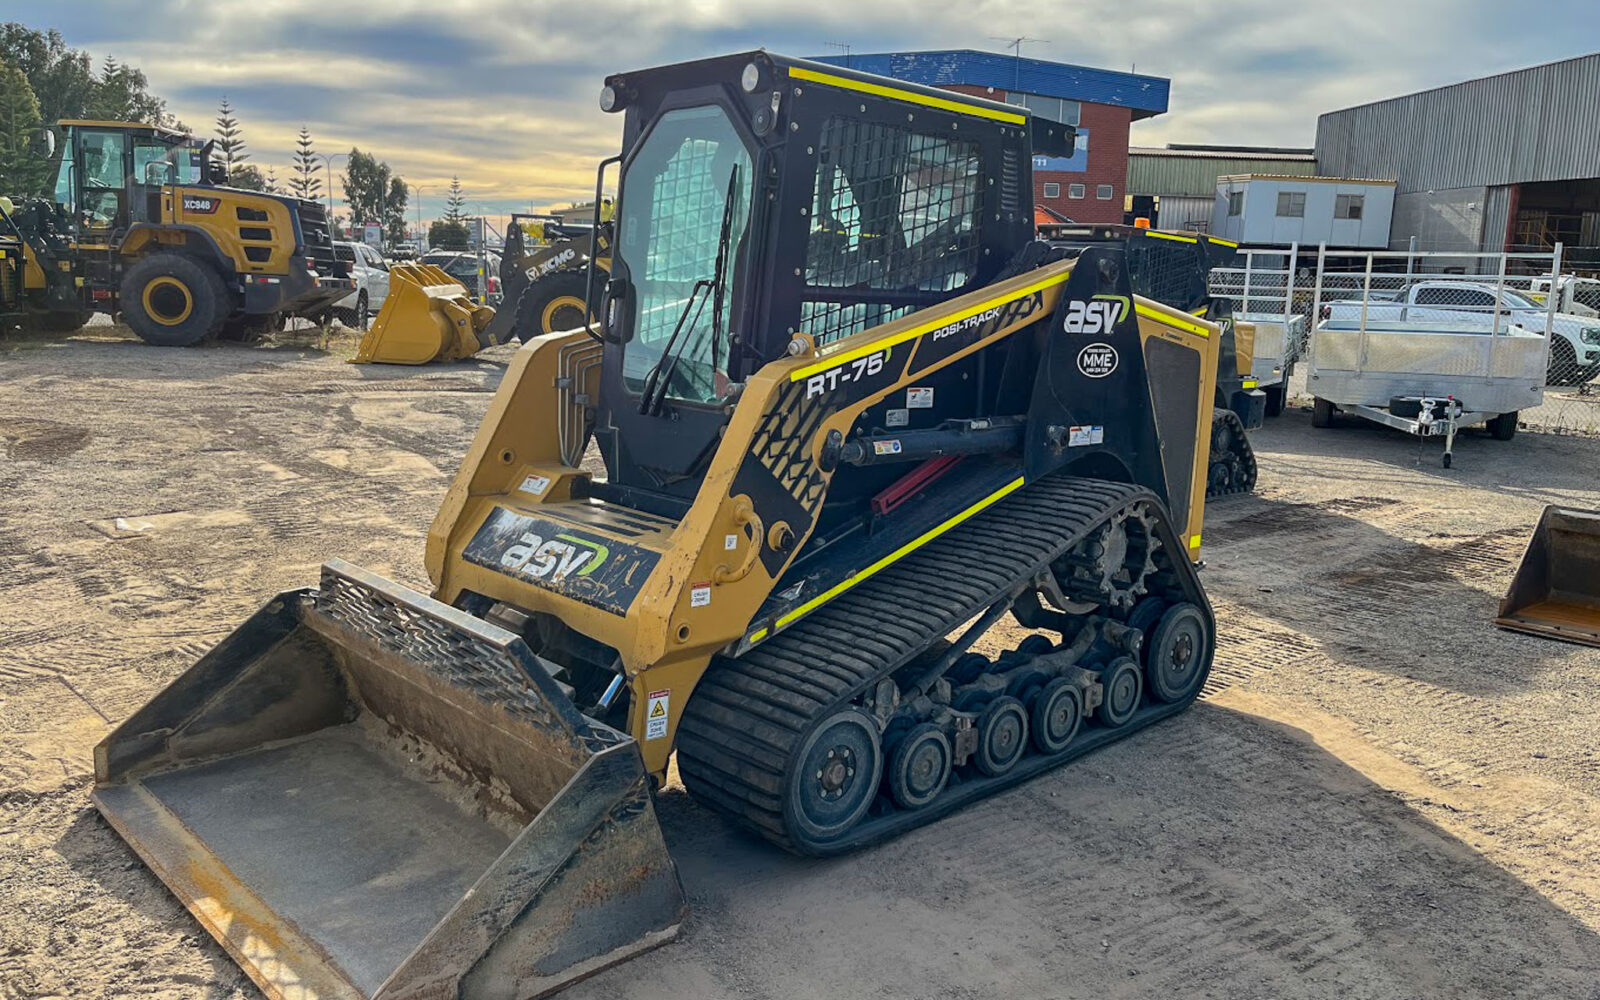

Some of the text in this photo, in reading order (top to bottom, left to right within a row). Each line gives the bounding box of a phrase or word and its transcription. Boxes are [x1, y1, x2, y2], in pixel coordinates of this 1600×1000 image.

[184, 199, 211, 209] XC948
[539, 247, 576, 274] XCMG
[932, 306, 1001, 342] POSI-TRACK
[1083, 353, 1113, 367] MME
[806, 351, 885, 400] RT-75
